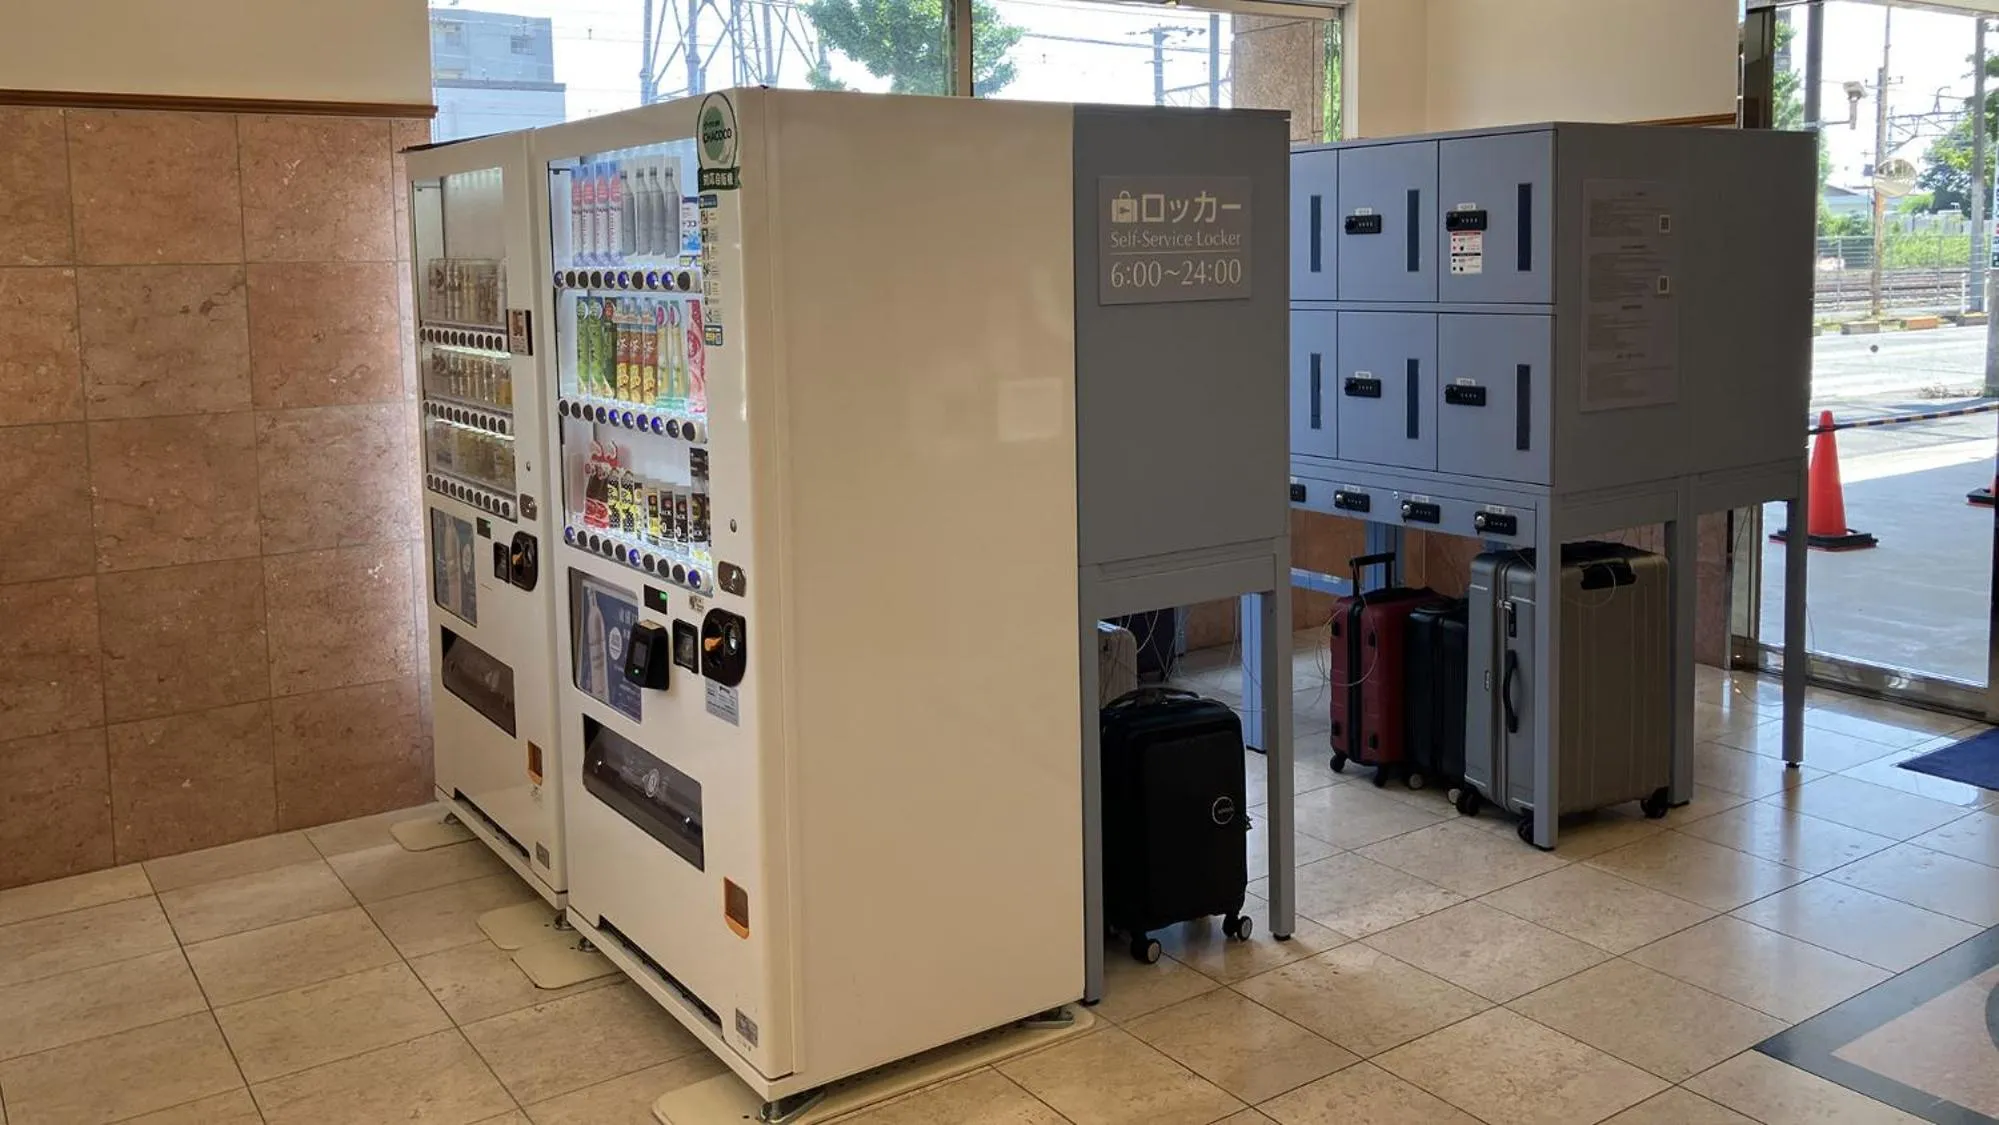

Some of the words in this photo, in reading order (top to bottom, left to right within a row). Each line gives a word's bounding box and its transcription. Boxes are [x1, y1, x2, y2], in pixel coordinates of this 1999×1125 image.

[1141, 190, 1241, 223] ロッカー
[1110, 228, 1193, 248] Self-Service
[1197, 228, 1241, 247] Locker
